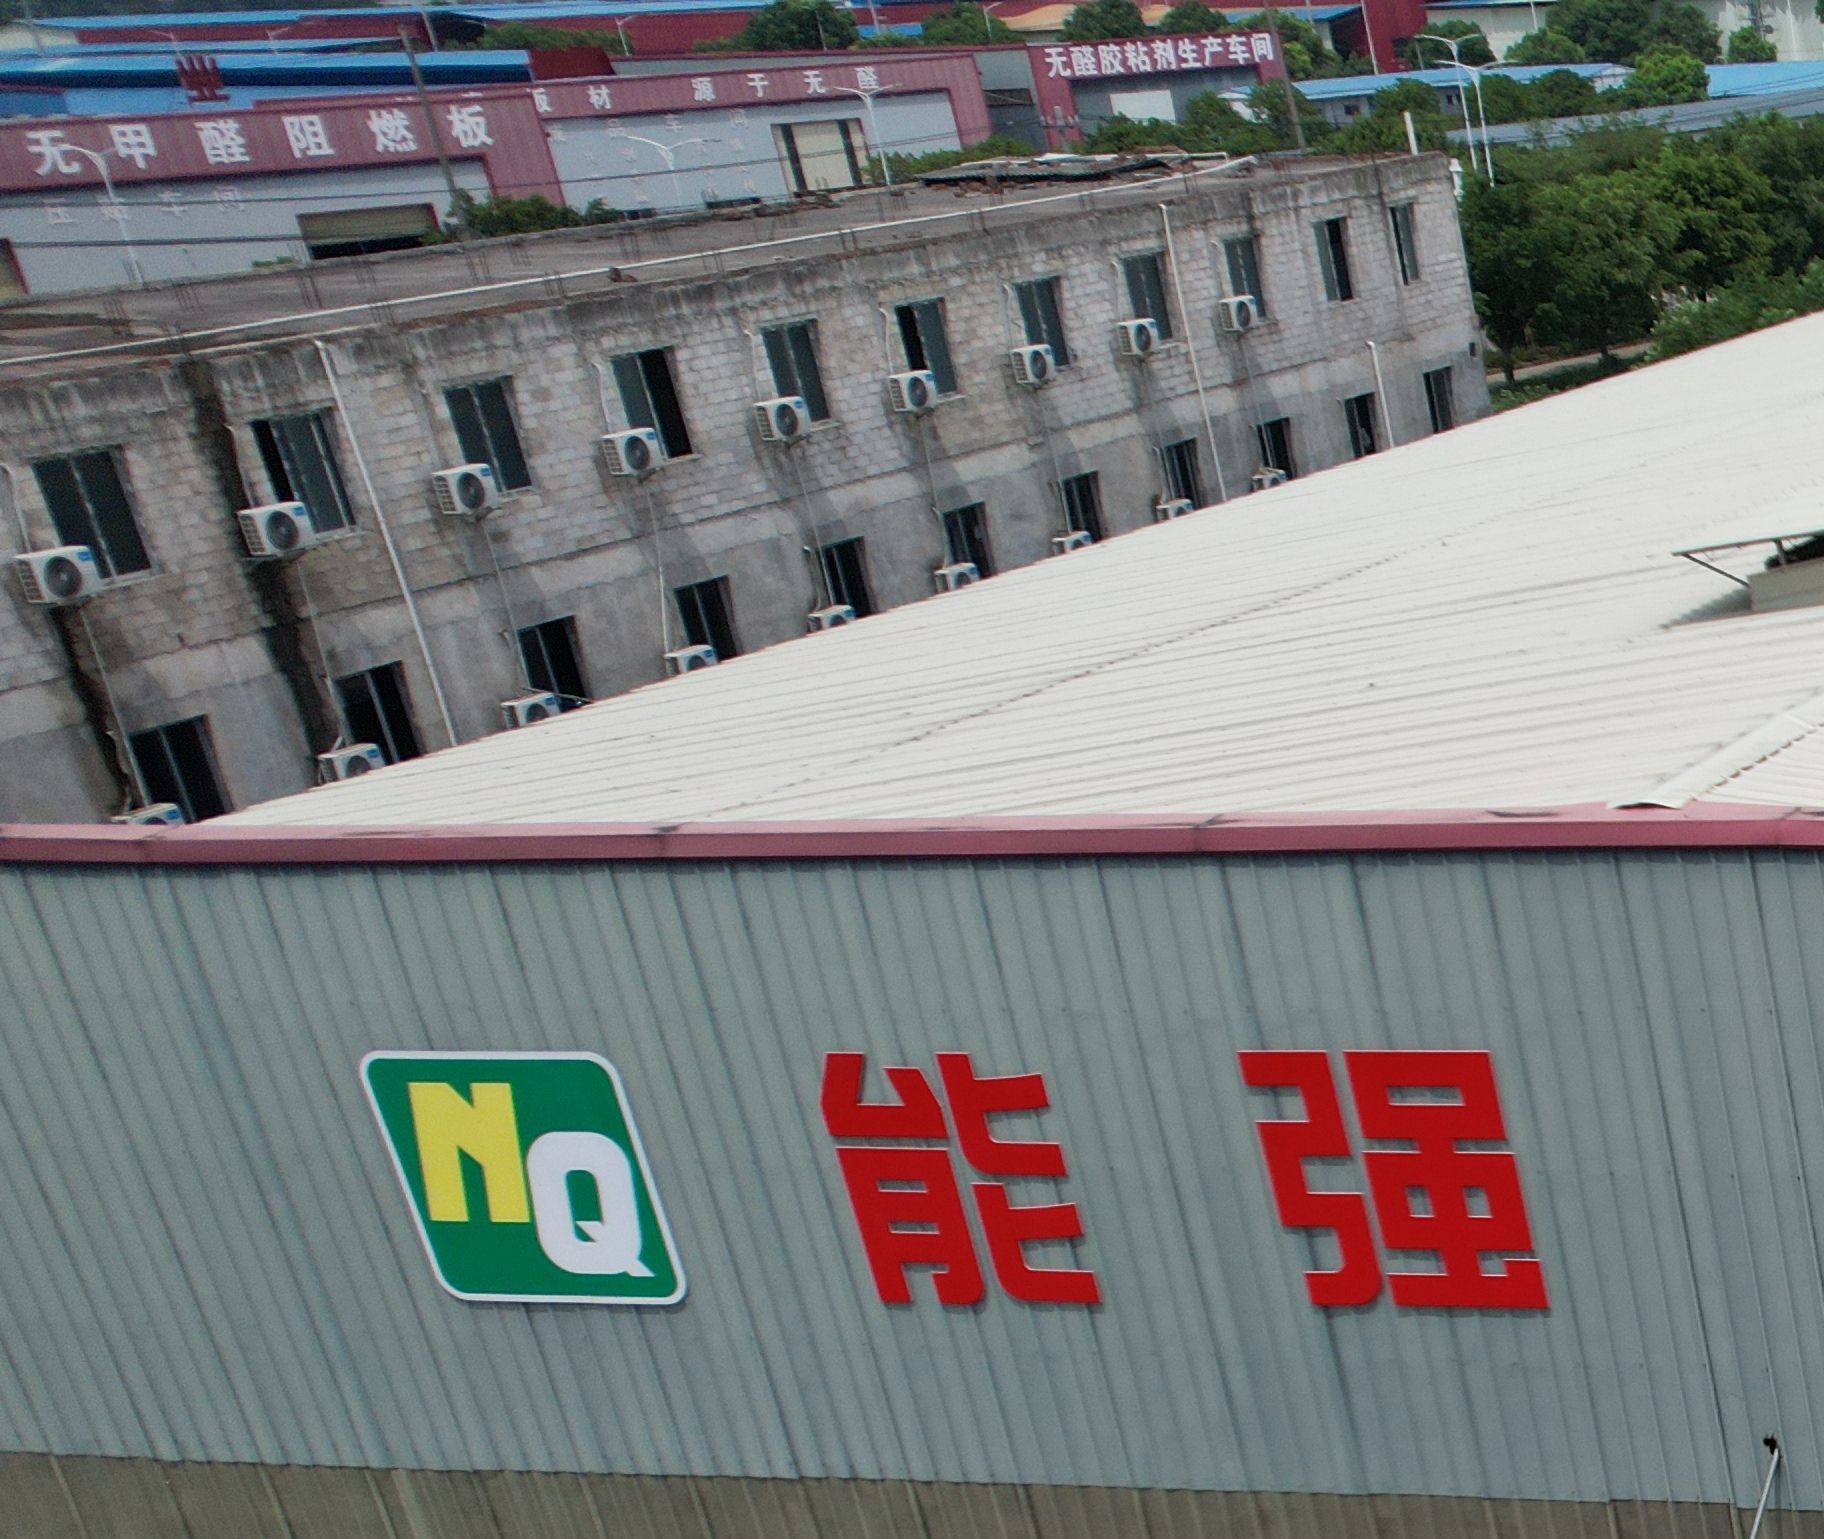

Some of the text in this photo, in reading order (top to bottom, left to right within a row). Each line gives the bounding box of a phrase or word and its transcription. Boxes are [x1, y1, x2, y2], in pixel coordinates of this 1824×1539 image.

[691, 66, 881, 102] 源于无醛
[1044, 33, 1275, 78] 无醛胶粘剂生产车间
[26, 107, 494, 176] 无甲醛阻燃板
[408, 1082, 655, 1278] NQ
[821, 1050, 1550, 1309] 能强
